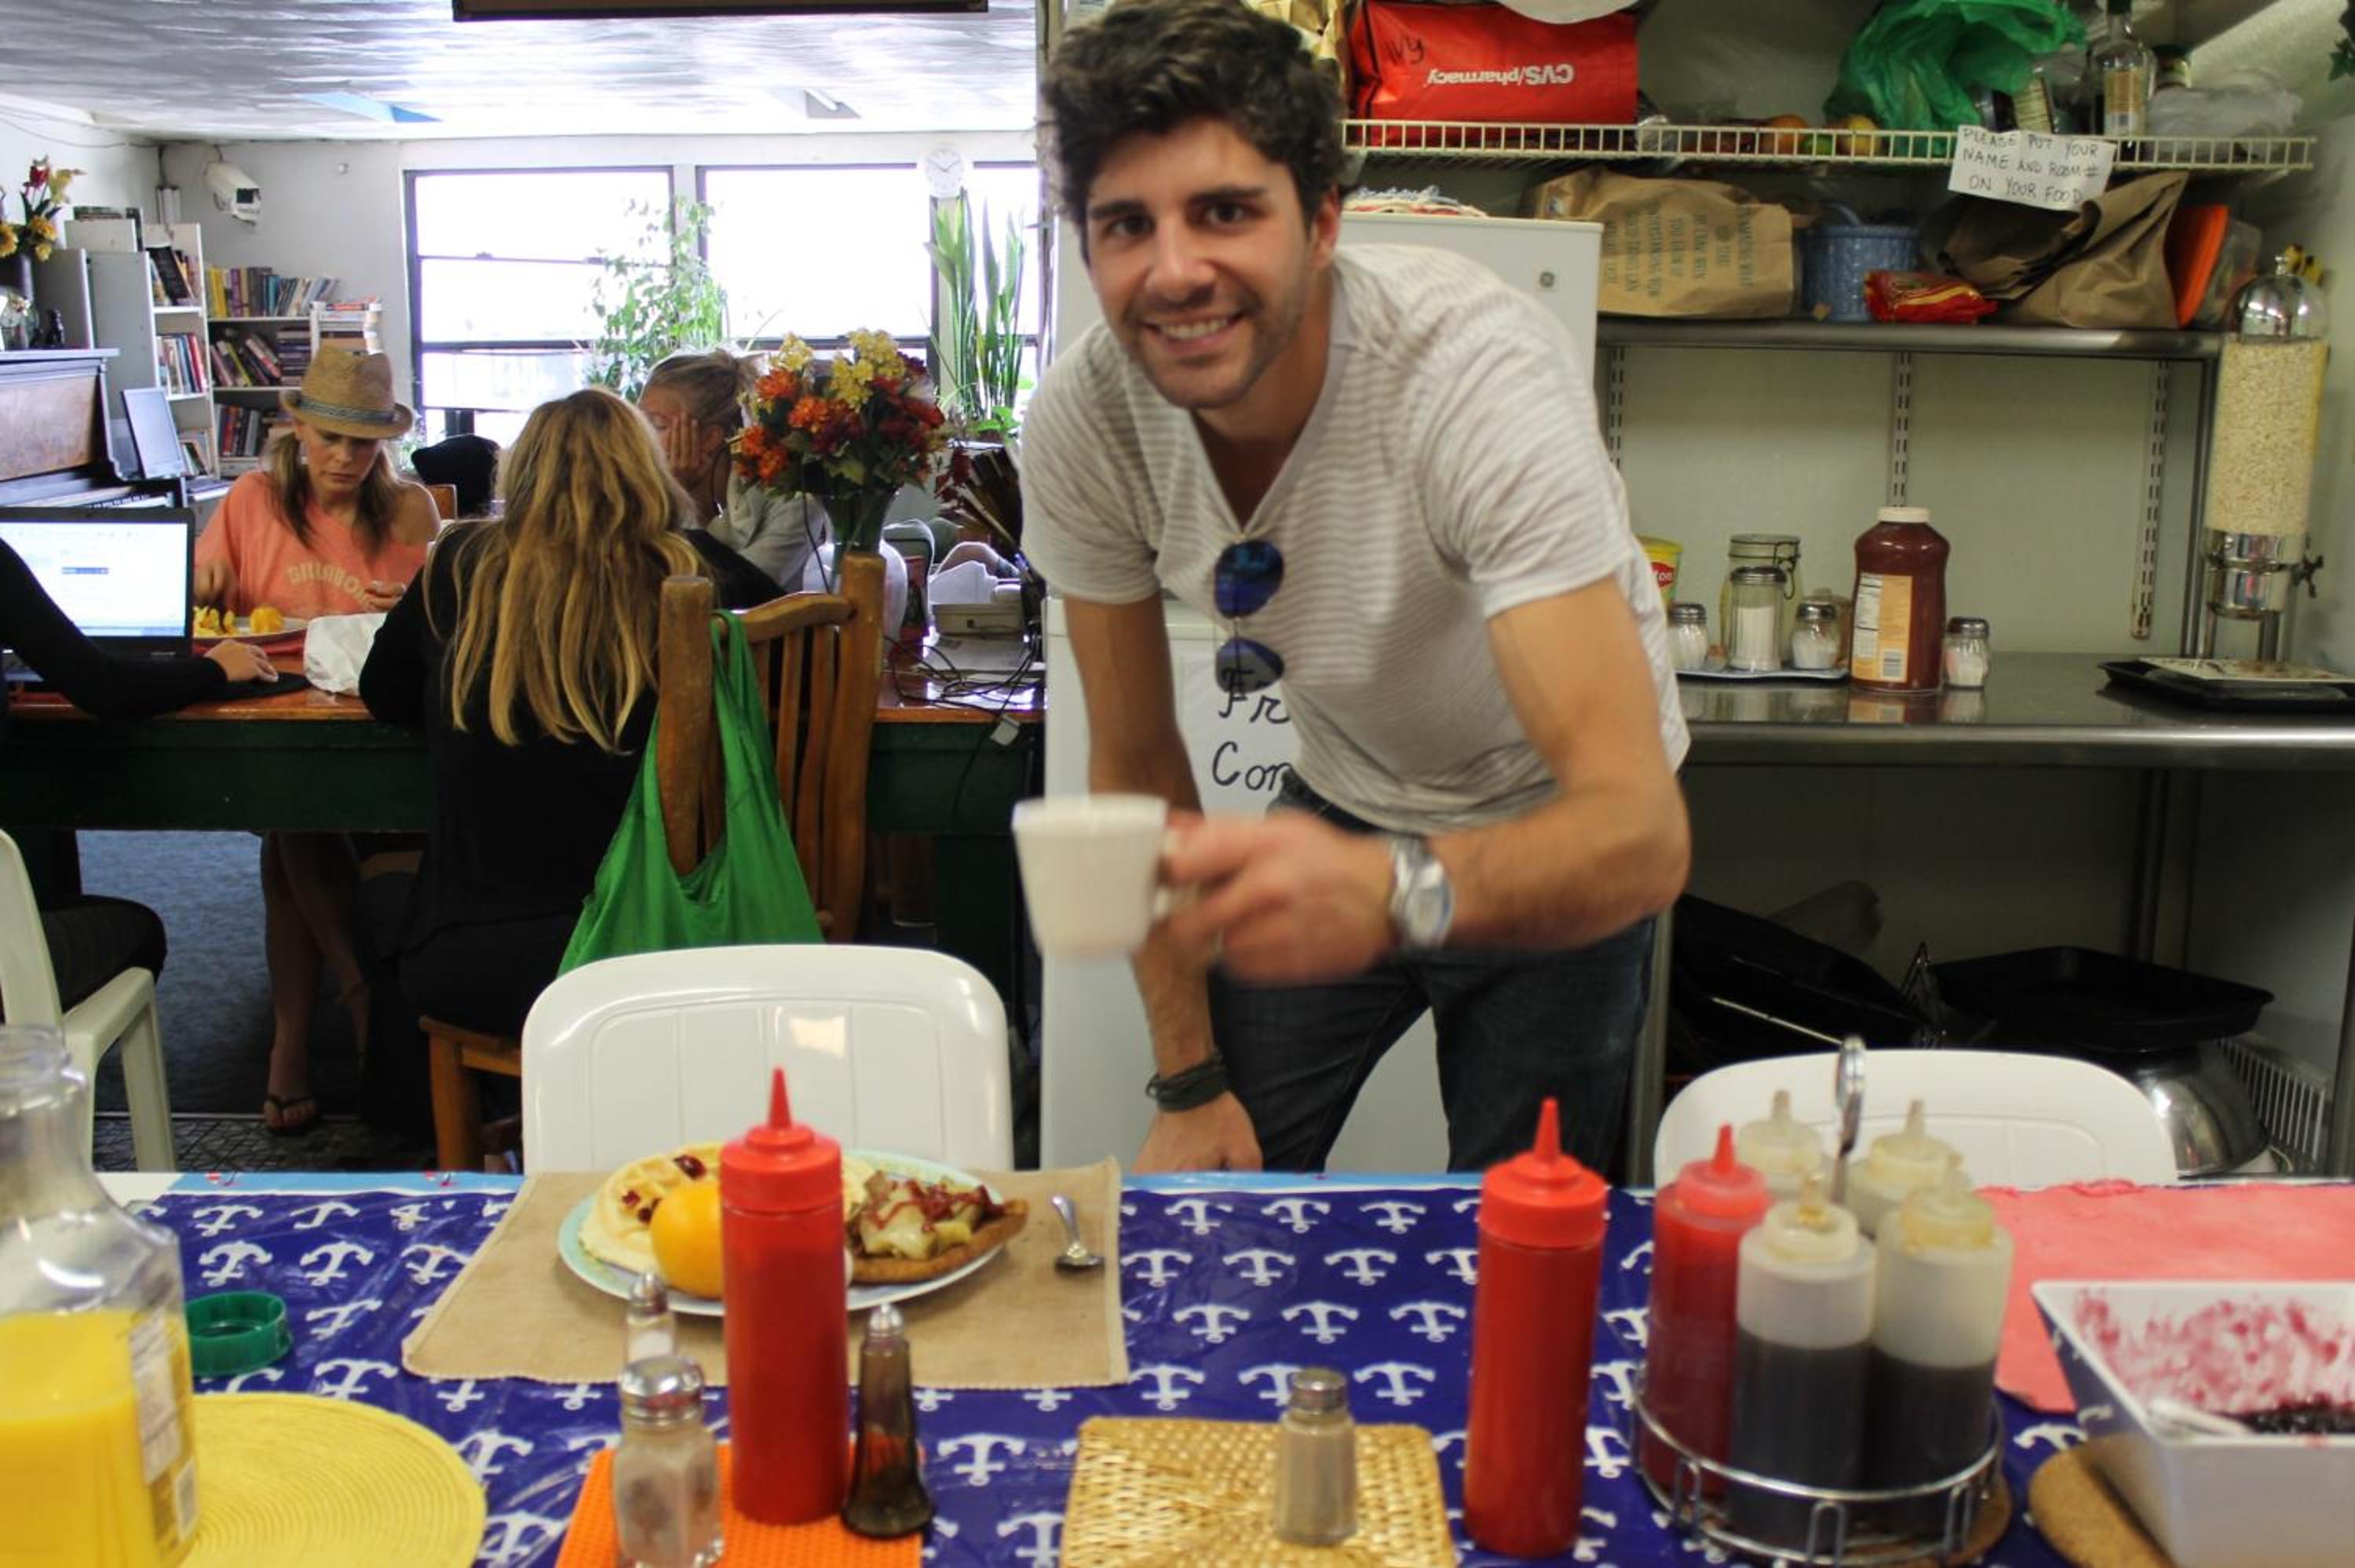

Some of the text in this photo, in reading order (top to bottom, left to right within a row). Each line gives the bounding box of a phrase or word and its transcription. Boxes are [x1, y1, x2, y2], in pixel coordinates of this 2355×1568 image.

[1426, 64, 1574, 86] CVS/pharmacy
[1964, 128, 2099, 160] PLEASE PUT YOUR
[1964, 148, 2010, 170] NAME
[2017, 160, 2043, 176] AND
[2049, 162, 2080, 177] ROOM
[1969, 175, 2083, 204] ON YOUR FOOD
